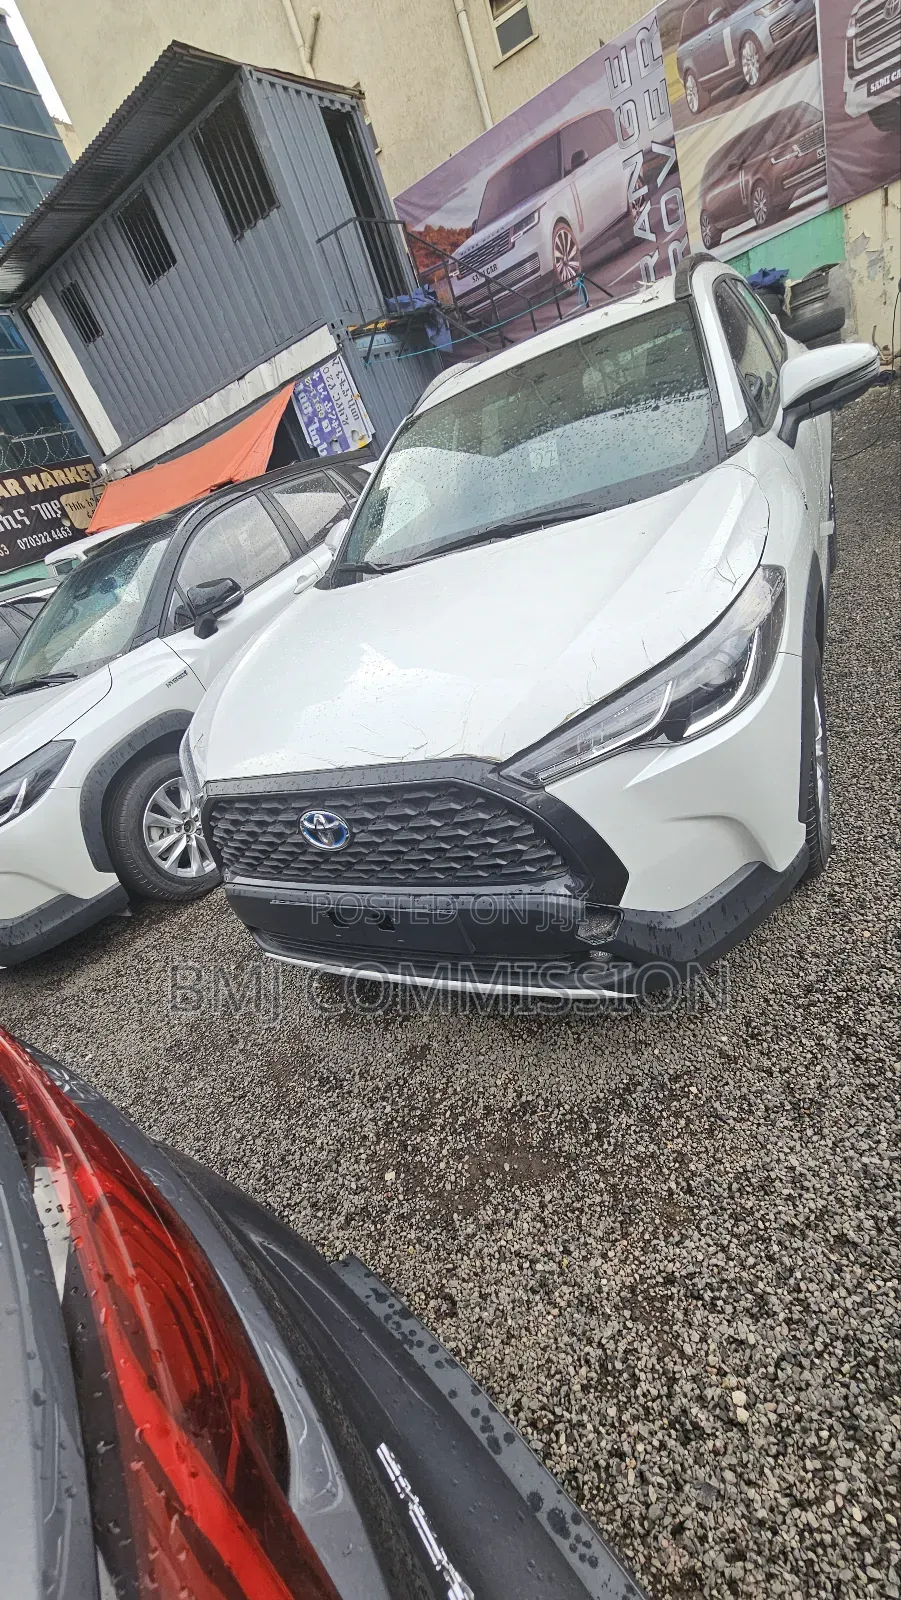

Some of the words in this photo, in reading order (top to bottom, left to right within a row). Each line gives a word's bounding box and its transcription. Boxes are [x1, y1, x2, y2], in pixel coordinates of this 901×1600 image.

[870, 75, 891, 93] SAMI
[635, 16, 690, 276] ROVER
[604, 46, 660, 283] RANGE
[486, 263, 498, 275] CAR
[22, 463, 98, 493] MARKET
